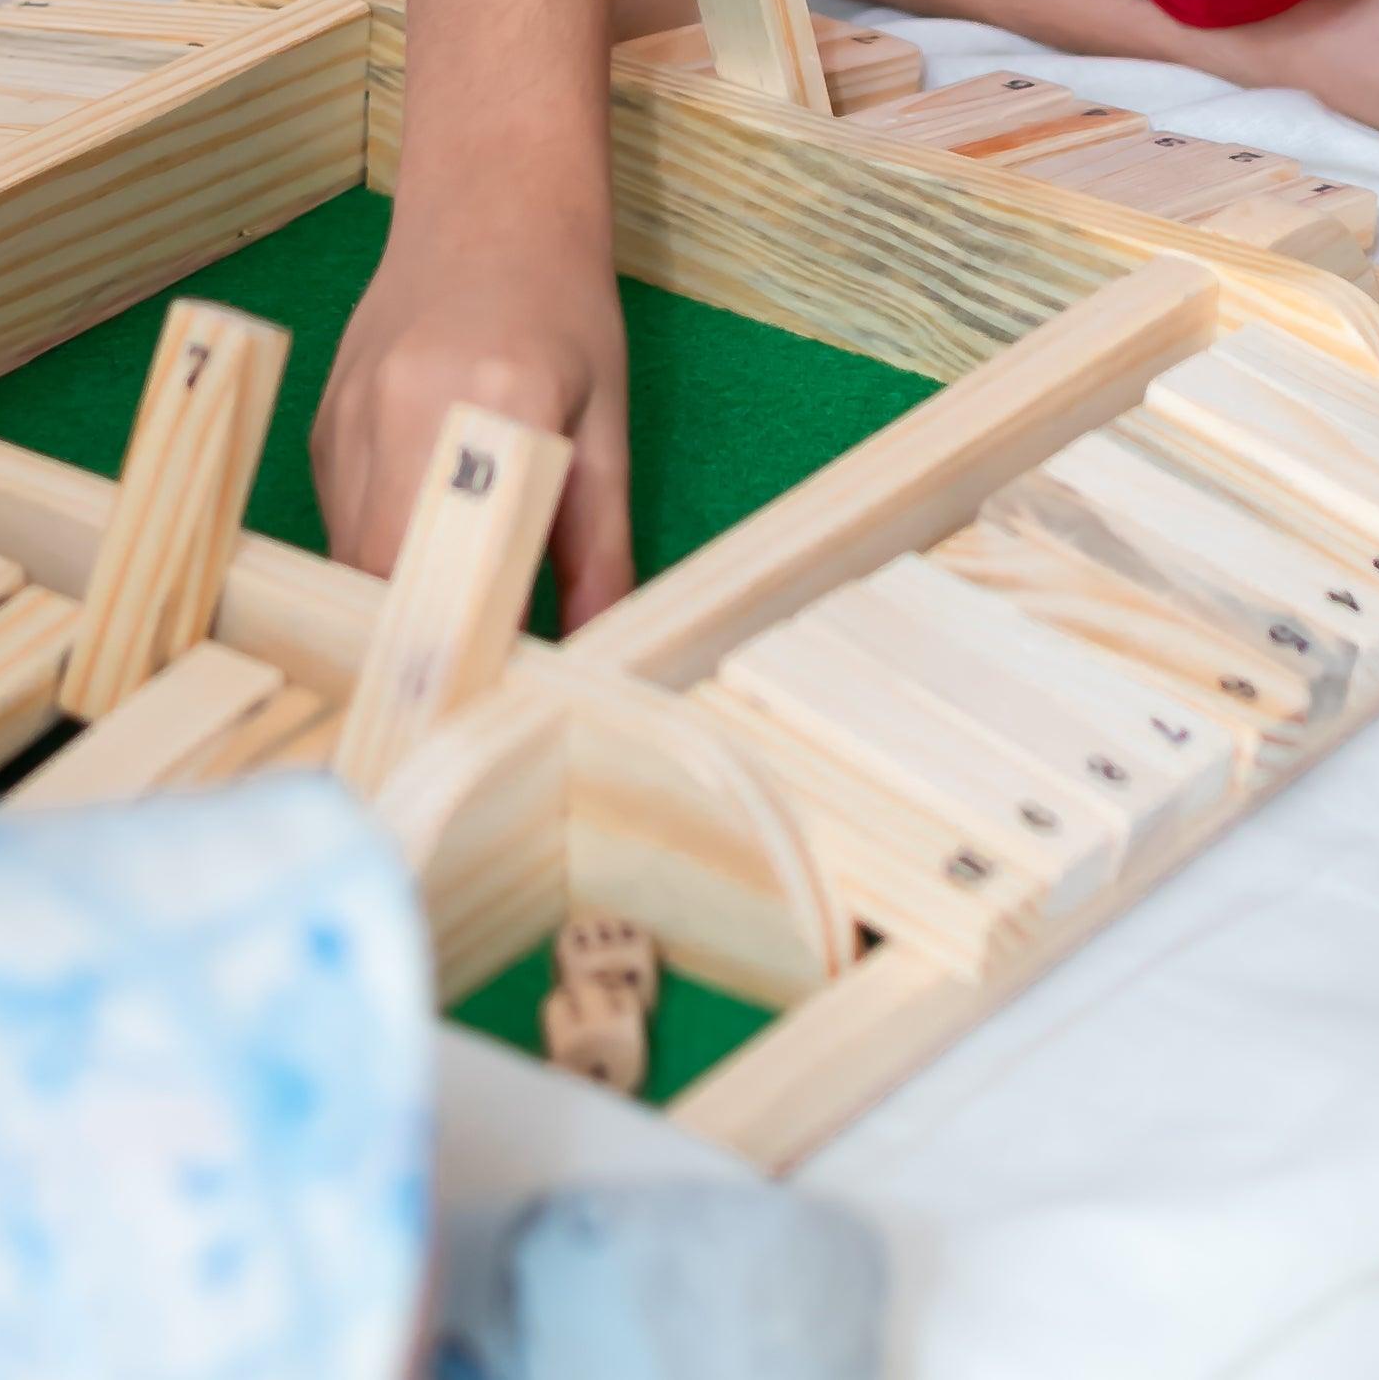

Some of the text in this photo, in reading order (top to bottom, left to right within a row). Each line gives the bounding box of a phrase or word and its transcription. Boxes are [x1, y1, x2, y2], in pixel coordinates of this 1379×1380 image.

[184, 343, 211, 390] 7
[1326, 591, 1362, 612] 4
[1269, 624, 1310, 655] 5
[1149, 716, 1192, 744] 7
